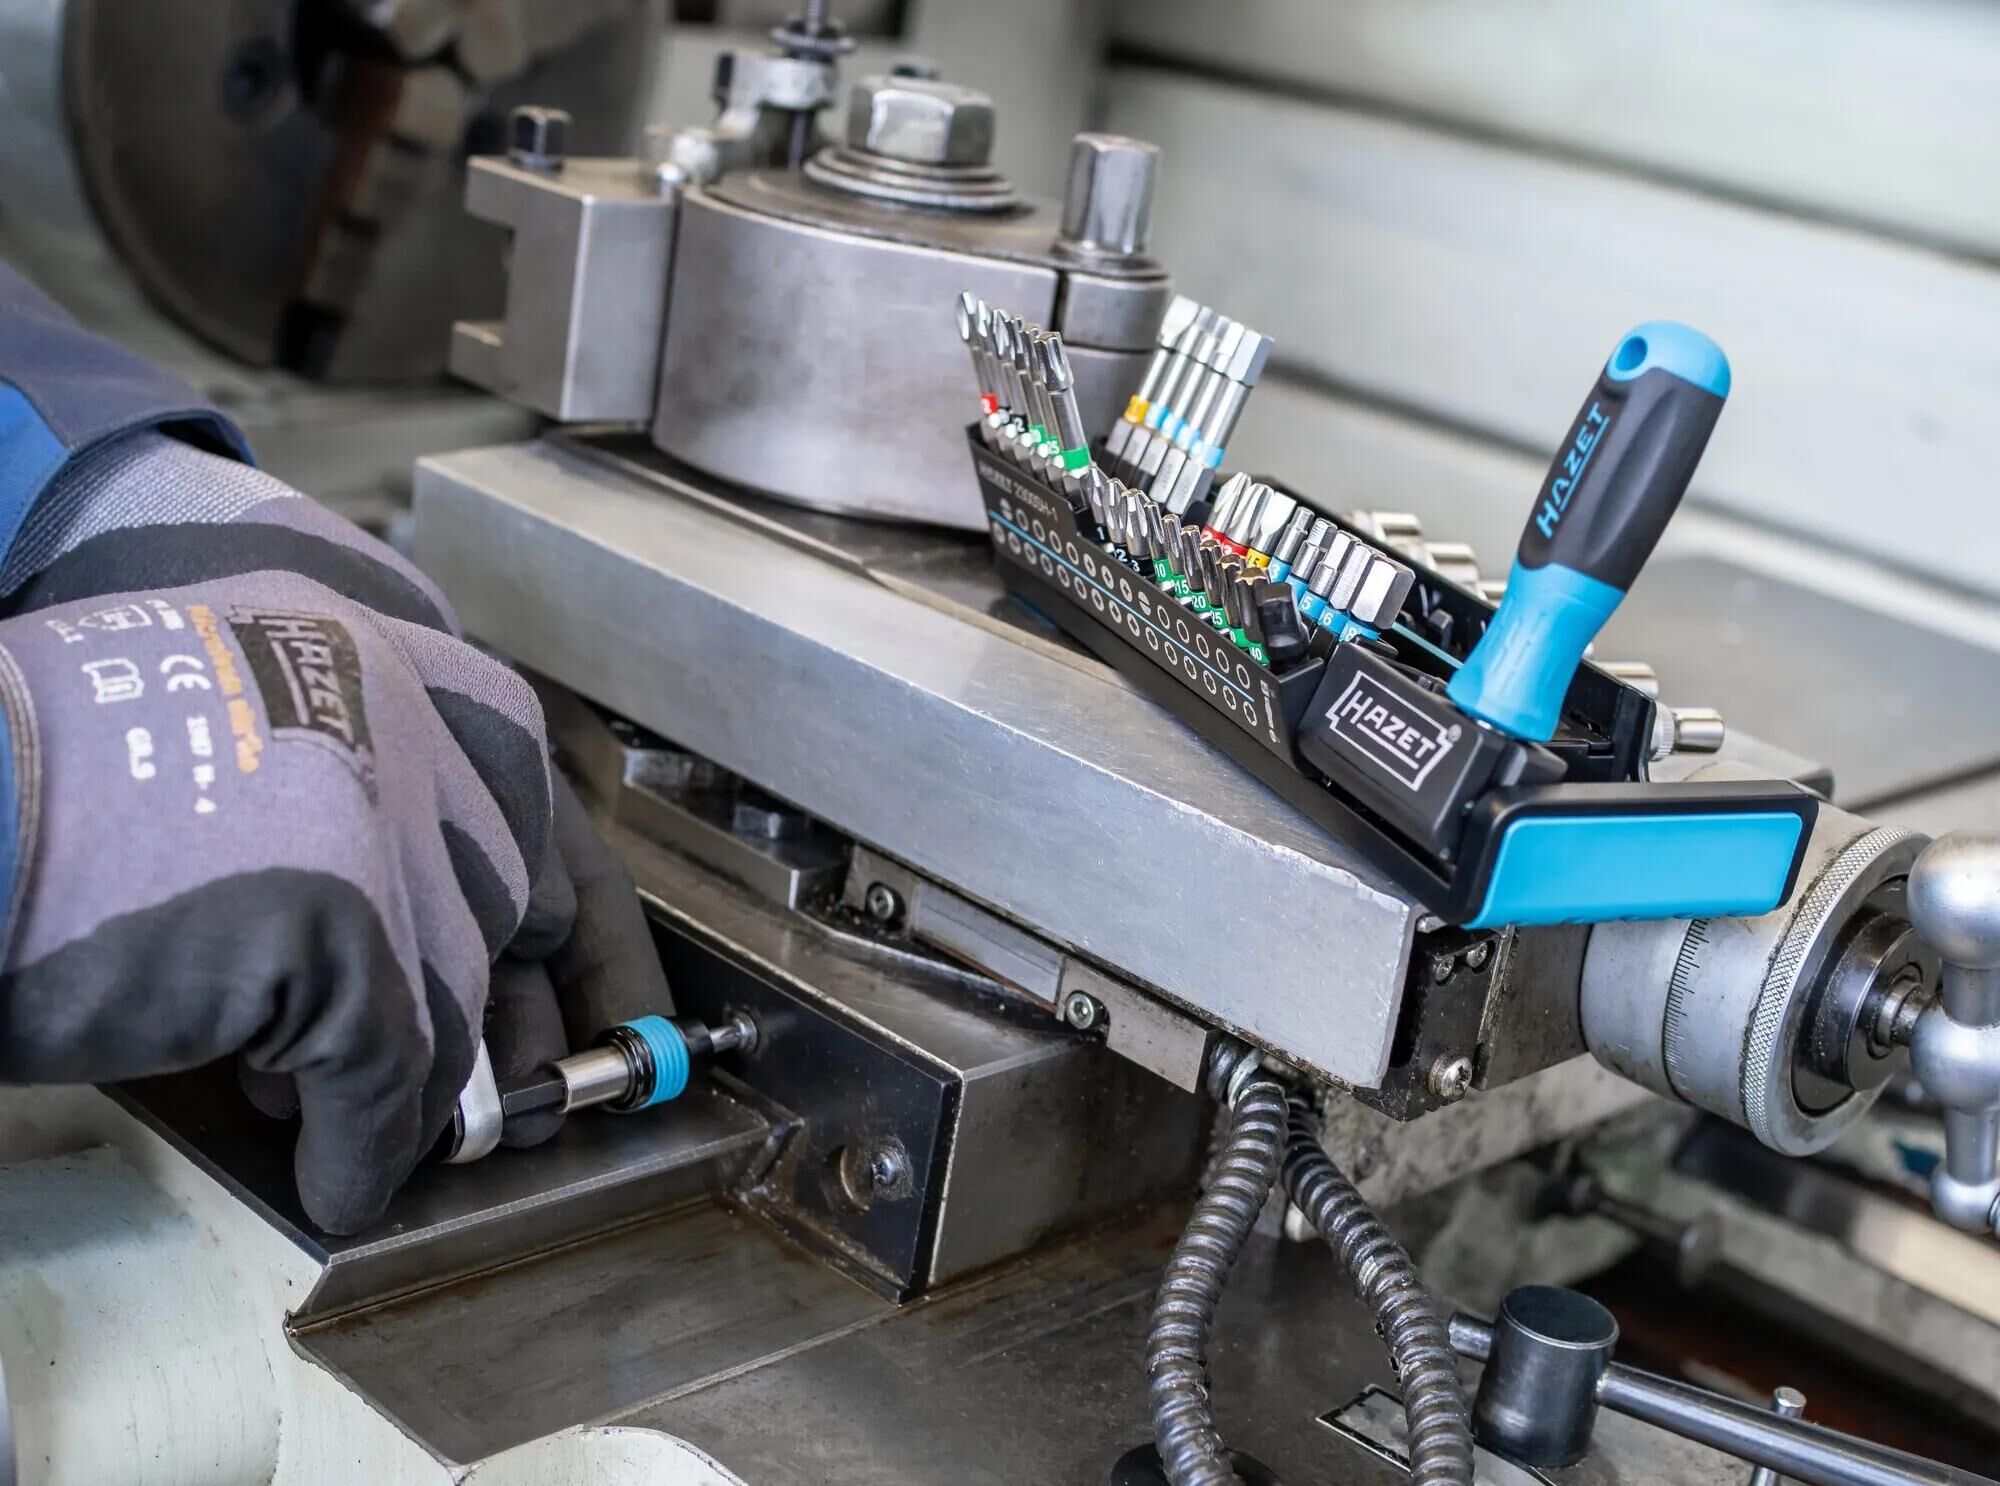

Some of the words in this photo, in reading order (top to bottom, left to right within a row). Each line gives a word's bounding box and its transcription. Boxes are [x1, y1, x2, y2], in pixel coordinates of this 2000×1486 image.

[1536, 402, 1602, 538] HAZET
[1096, 526, 1105, 540] 1
[1115, 548, 1128, 562] 2
[1130, 559, 1140, 572] 3
[1154, 562, 1166, 577] 10
[1175, 579, 1189, 595] 15
[1192, 594, 1206, 609] 20
[1301, 596, 1313, 610] 5
[1211, 609, 1223, 626] 25
[1321, 612, 1333, 626] 6
[260, 617, 355, 744] HAZET
[1340, 690, 1436, 759] HAZET
